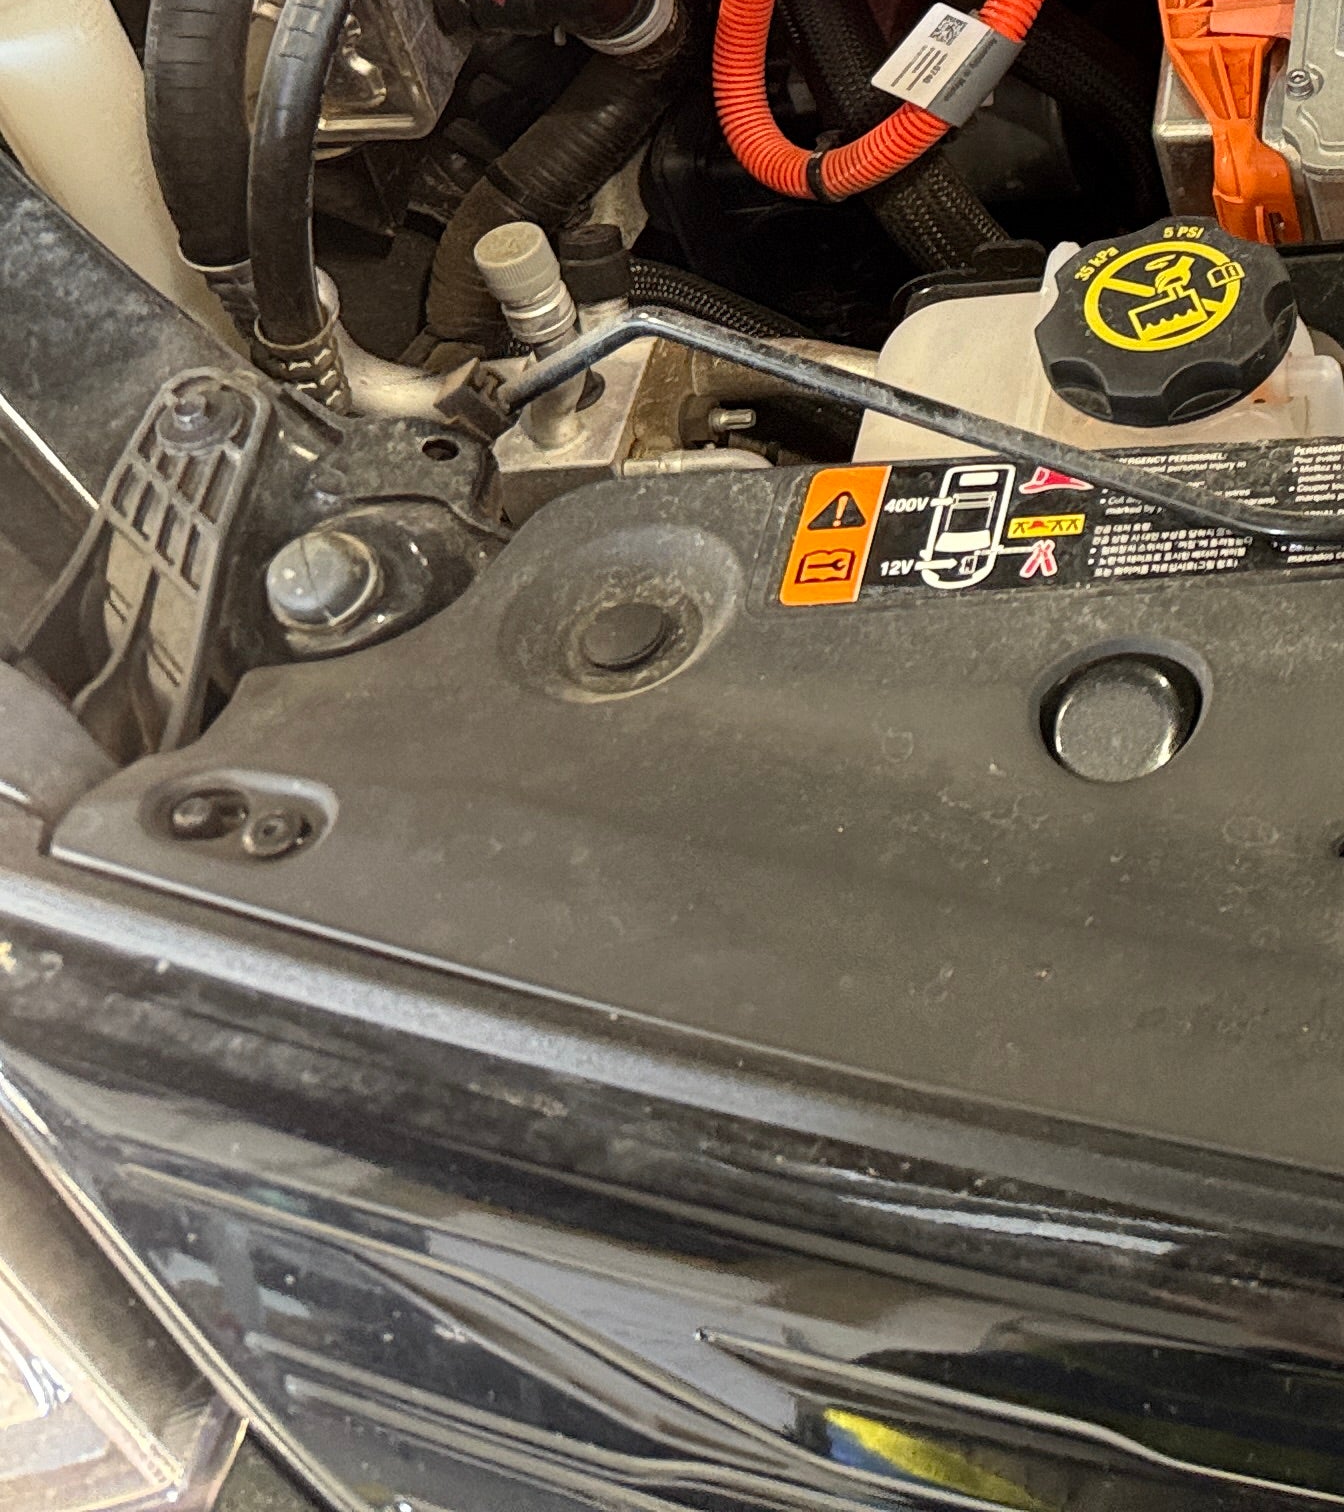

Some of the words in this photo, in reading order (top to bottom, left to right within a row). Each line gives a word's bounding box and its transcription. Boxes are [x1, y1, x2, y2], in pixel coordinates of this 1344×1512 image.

[1162, 226, 1175, 239] 5
[1177, 226, 1205, 239] PSI
[1074, 266, 1093, 282] 35
[1088, 246, 1120, 269] kPa
[884, 497, 931, 514] 400V
[879, 560, 916, 577] 12V
